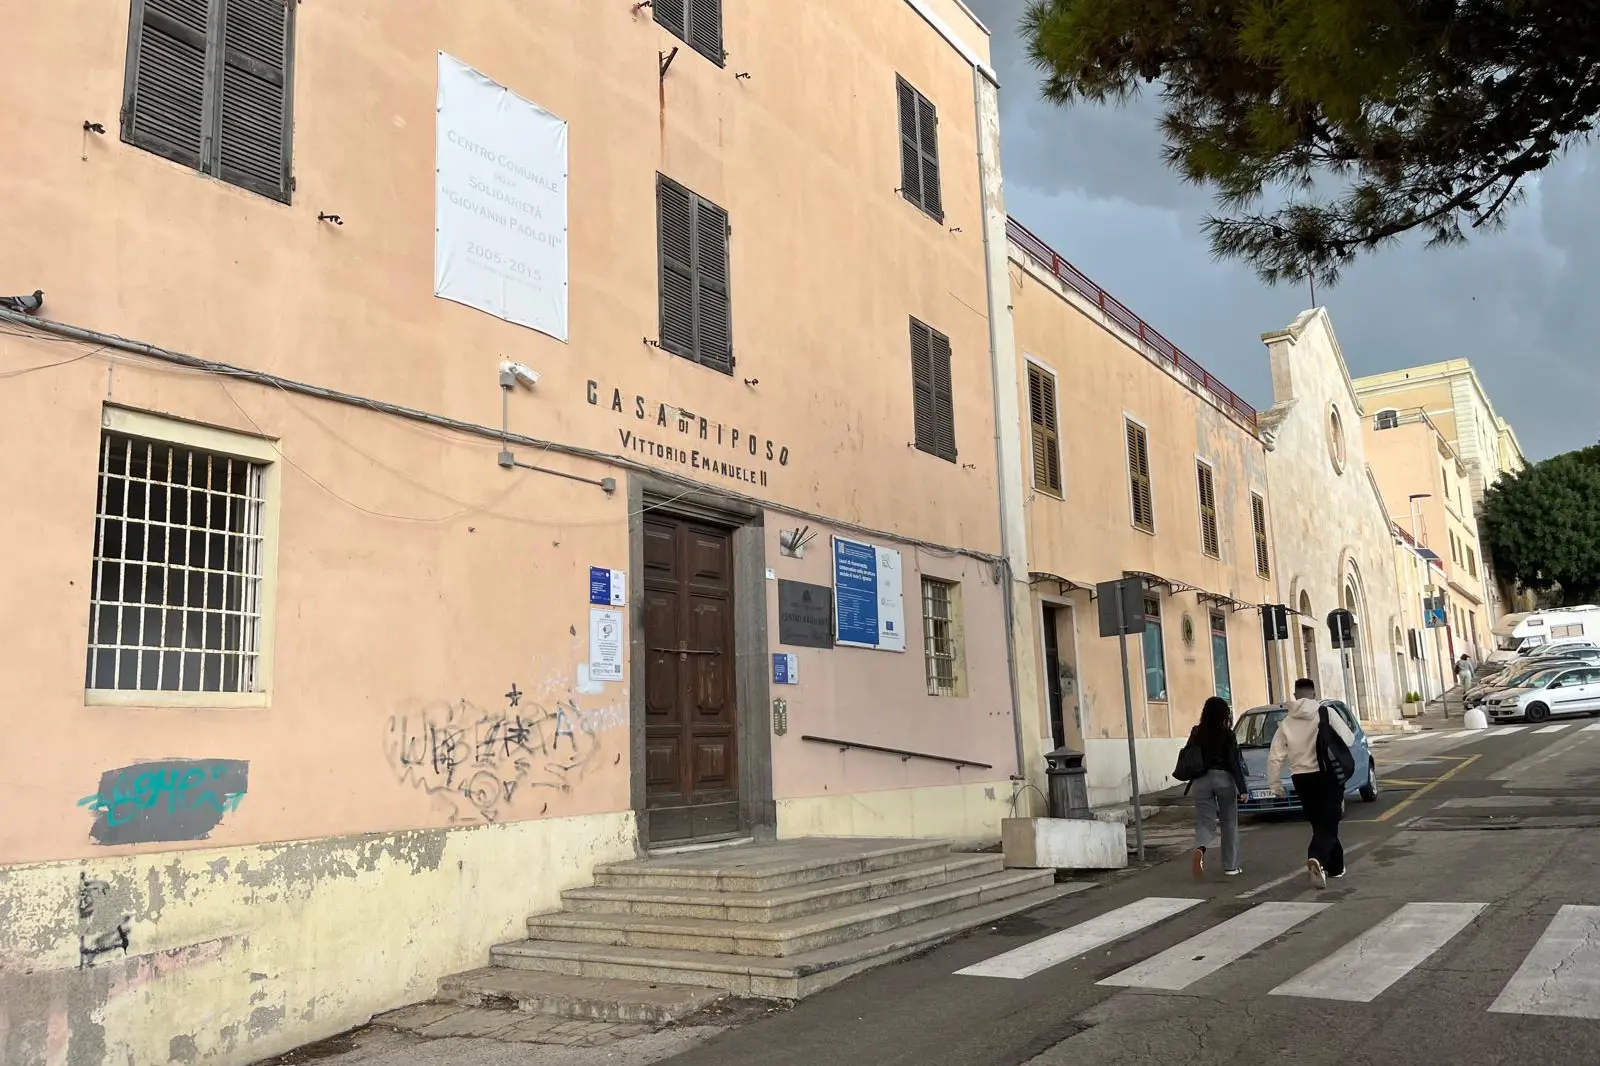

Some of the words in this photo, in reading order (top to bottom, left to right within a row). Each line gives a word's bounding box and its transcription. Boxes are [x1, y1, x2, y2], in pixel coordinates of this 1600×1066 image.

[447, 129, 495, 162] CENTRO
[498, 154, 558, 193] COMUNALE
[468, 175, 543, 220] SOLIDARIETÀ
[510, 218, 545, 243] PAOLO
[586, 379, 667, 428] CASA
[678, 418, 689, 434] DI
[699, 416, 789, 466] RIPOSO
[618, 428, 686, 464] VITTORIO
[691, 449, 756, 484] EMANUELE
[759, 469, 768, 487] II
